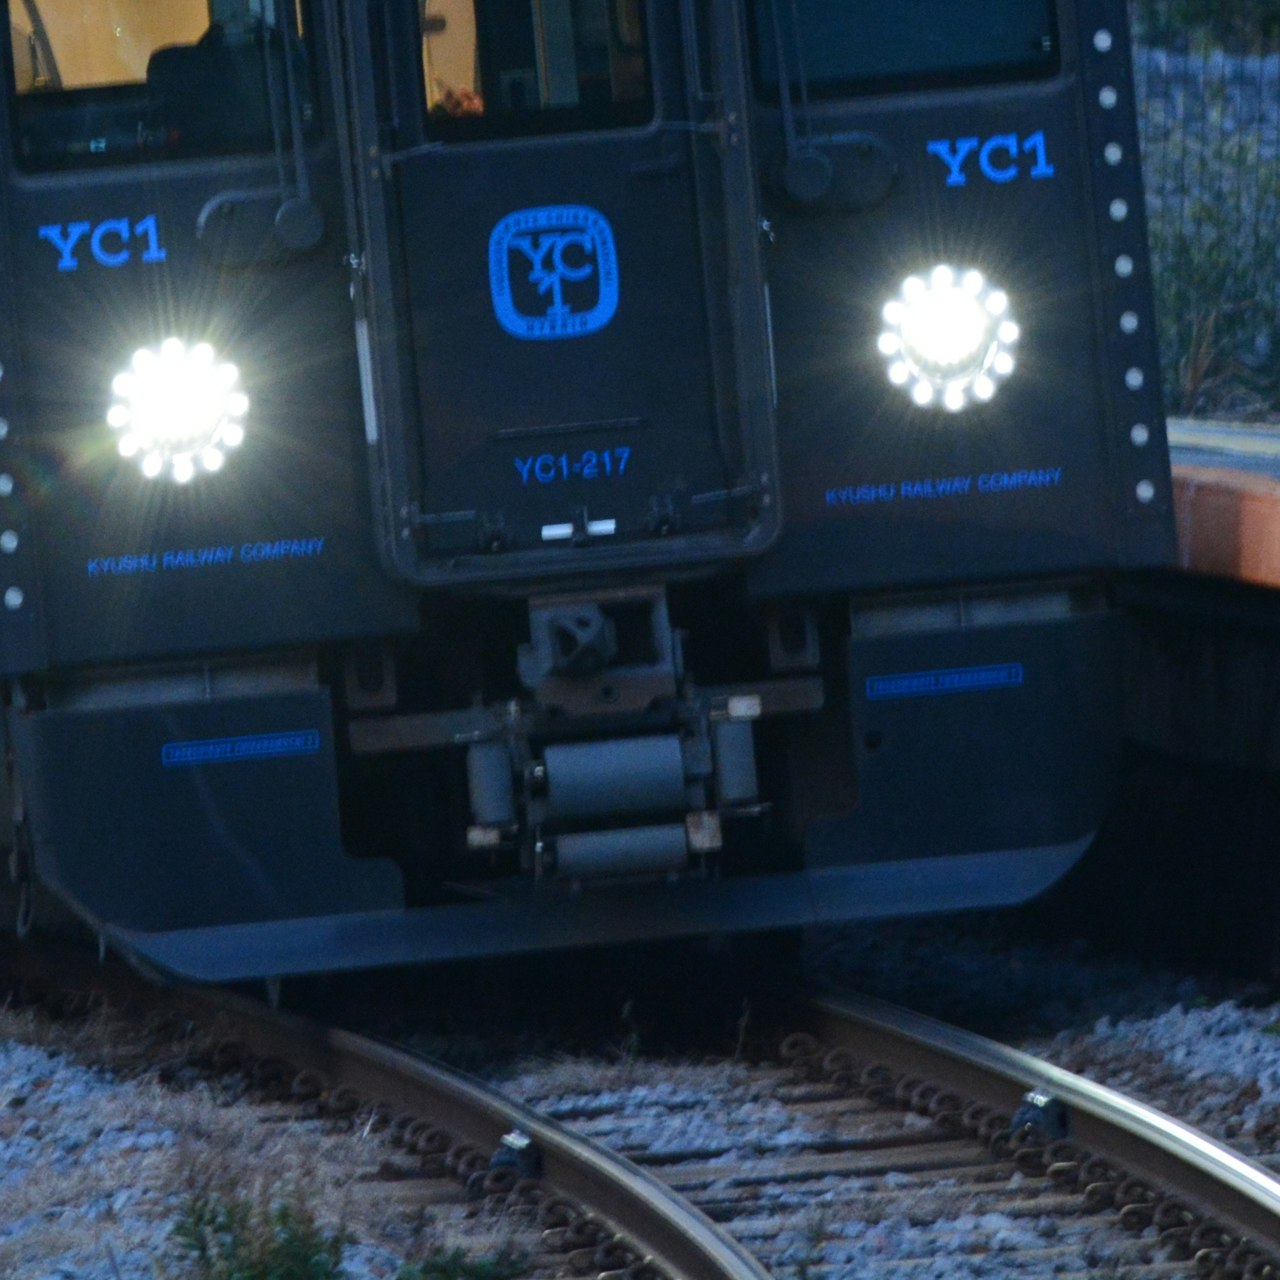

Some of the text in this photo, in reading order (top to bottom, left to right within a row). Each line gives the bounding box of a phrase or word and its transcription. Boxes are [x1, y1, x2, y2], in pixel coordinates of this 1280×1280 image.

[928, 131, 1055, 186] YC1
[39, 215, 166, 271] YC1
[513, 446, 633, 485] YC1-217
[824, 468, 1063, 506] KYUSHU RAILWAY COMPANY
[87, 538, 325, 578] KYUSHU RAILWAY COMPANY
